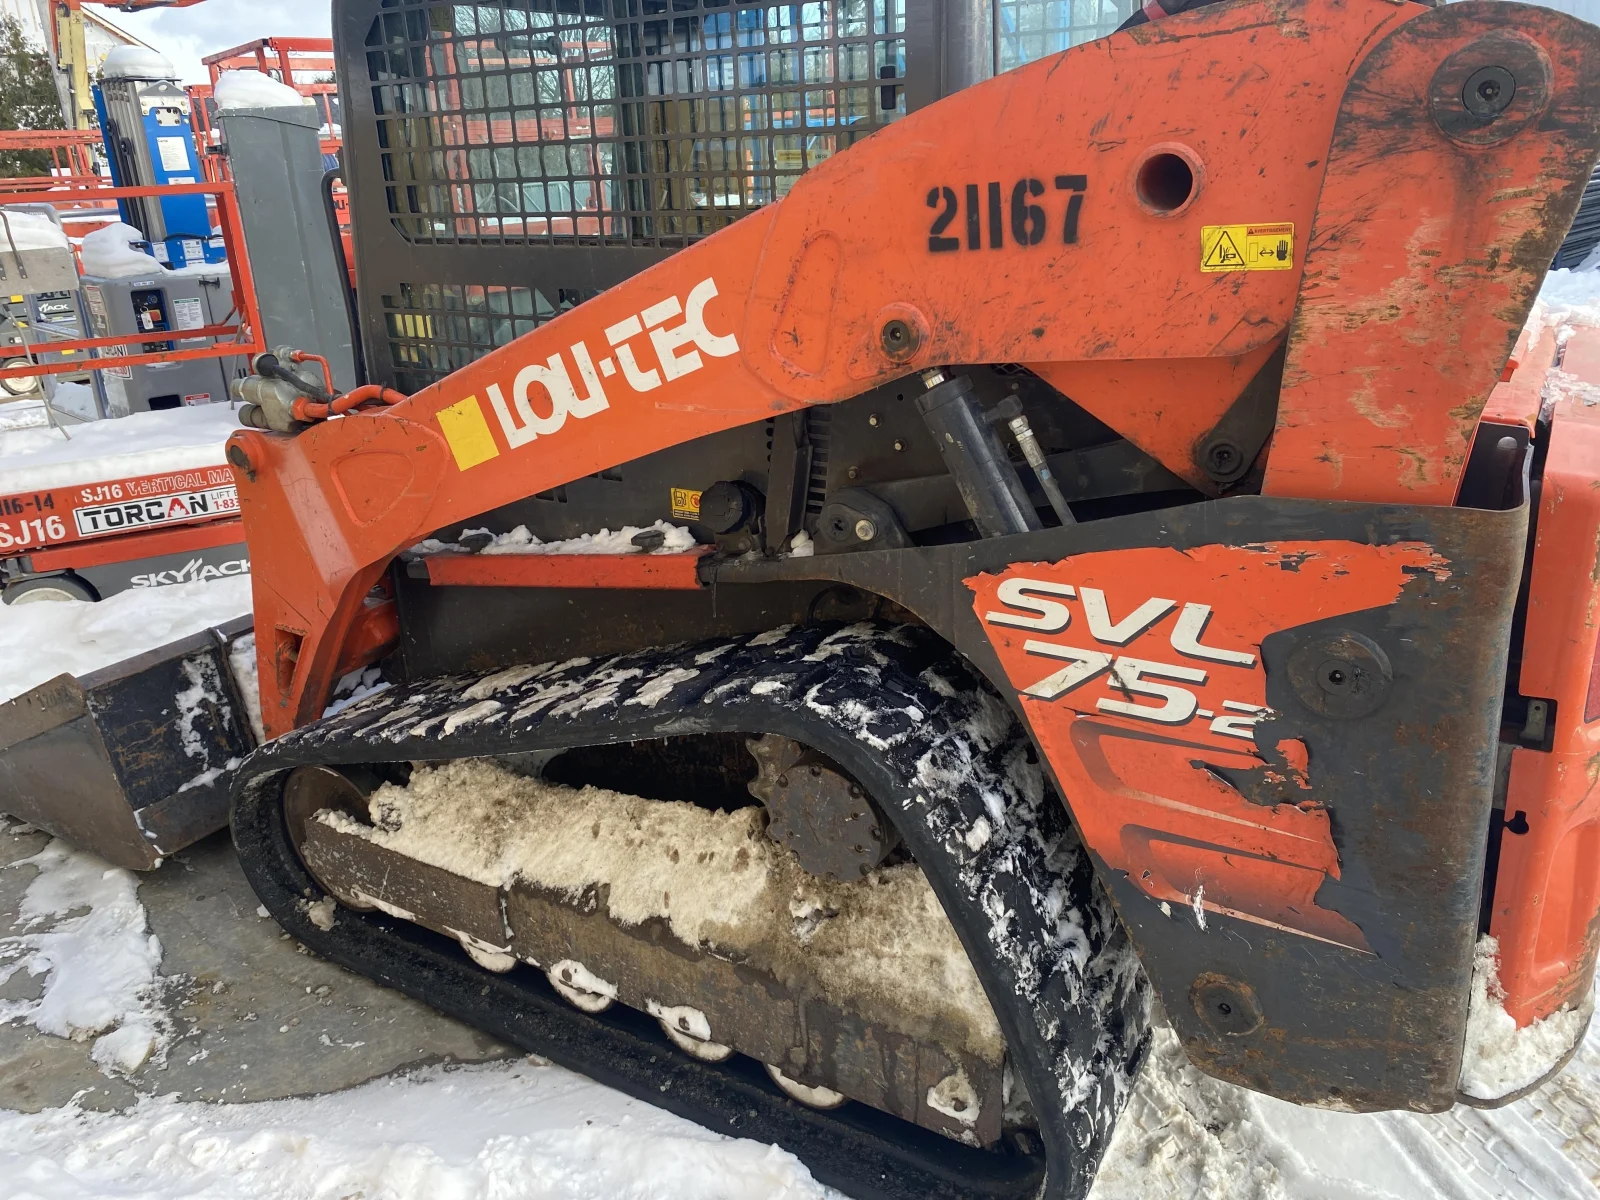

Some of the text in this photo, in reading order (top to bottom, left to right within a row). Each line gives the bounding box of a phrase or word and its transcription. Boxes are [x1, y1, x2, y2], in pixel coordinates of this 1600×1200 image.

[927, 175, 1087, 252] 21167
[486, 277, 740, 450] LOU-TEC
[81, 468, 236, 503] SJ16 VERTICAL MA
[83, 494, 209, 529] TORCAN
[211, 490, 231, 500] LIFT
[0, 516, 66, 547] SJ16
[985, 577, 1256, 665] SVL
[1022, 639, 1276, 739] 75-2
